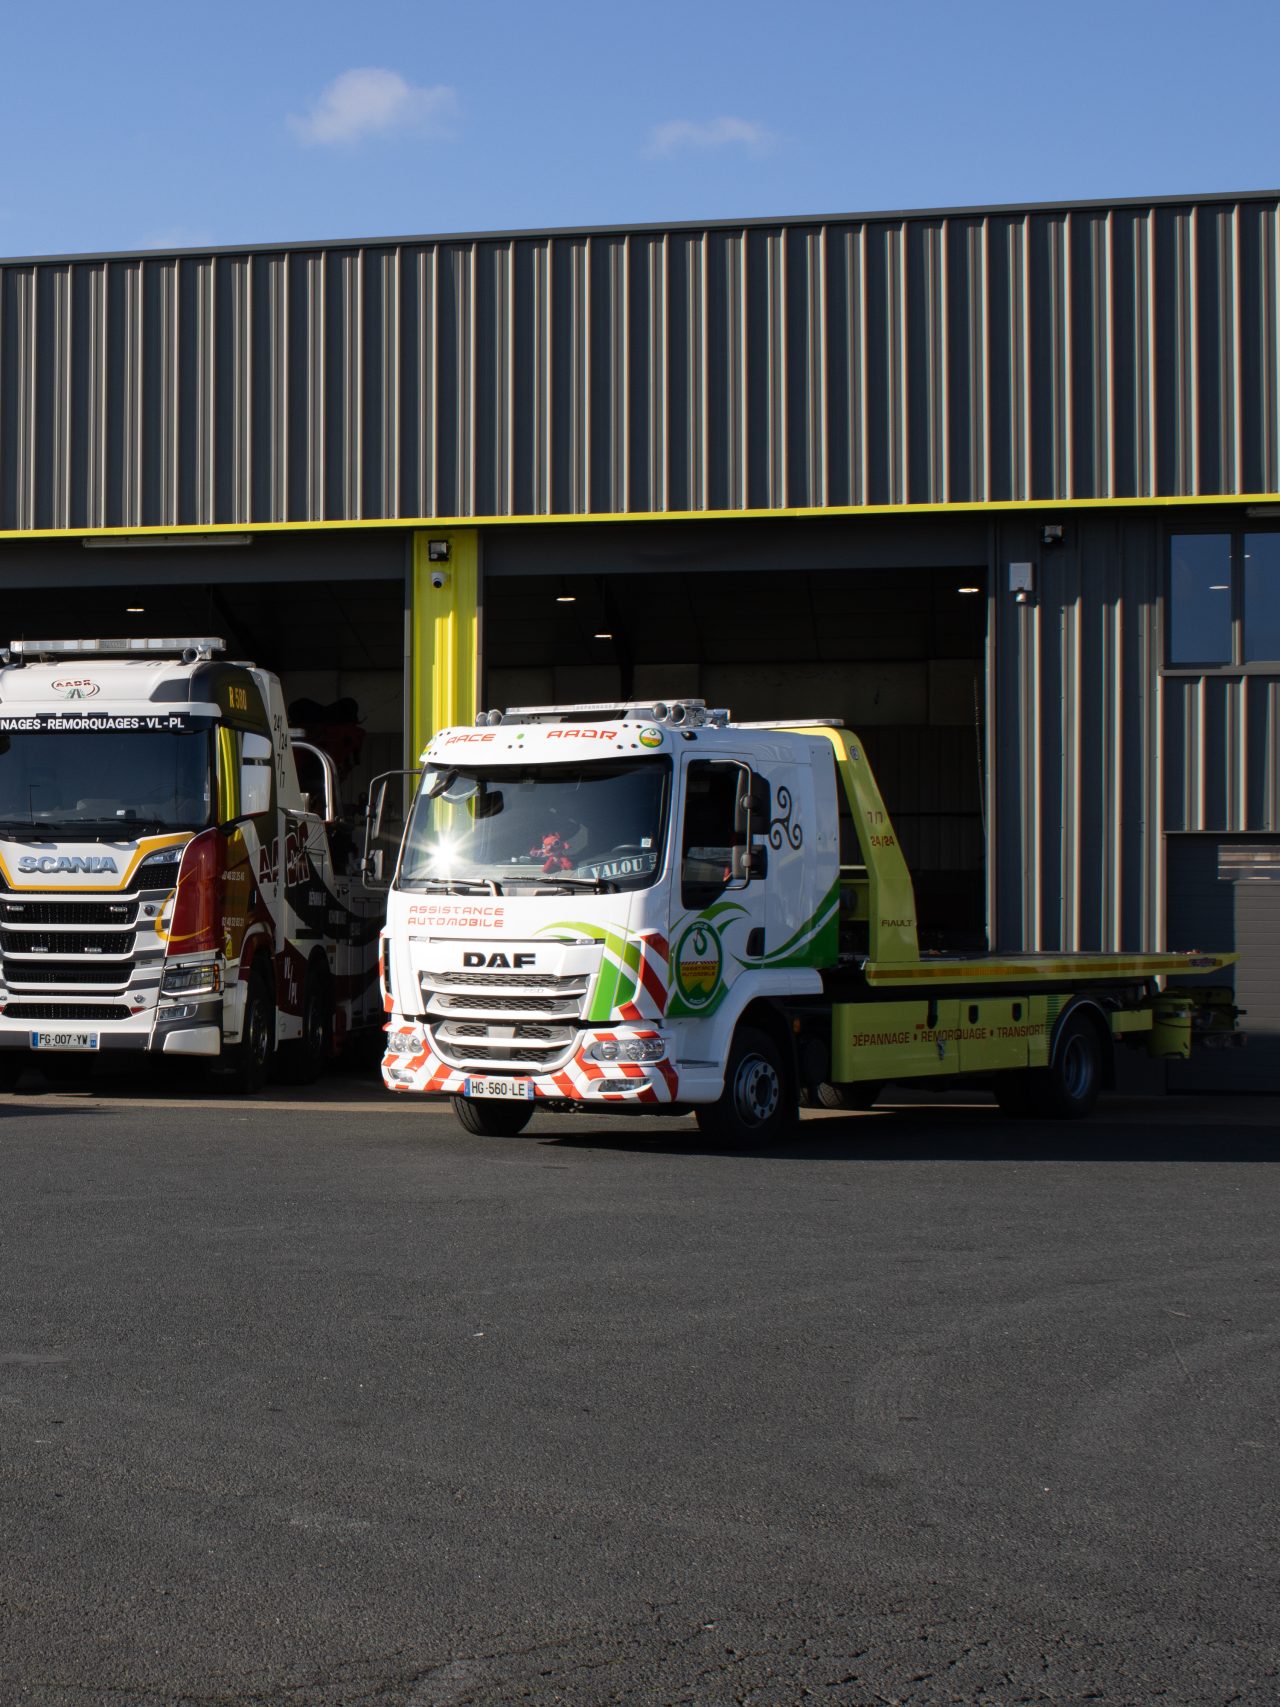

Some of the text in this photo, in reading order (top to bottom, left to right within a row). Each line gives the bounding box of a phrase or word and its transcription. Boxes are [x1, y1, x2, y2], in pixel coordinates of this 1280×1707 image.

[55, 679, 91, 688] AADR
[445, 733, 497, 746] AACE
[546, 729, 618, 741] AADR
[870, 835, 895, 848] 24/24
[18, 856, 119, 874] SCANIA
[591, 858, 644, 880] VALOU
[409, 905, 505, 916] ASSISTANCE
[408, 917, 504, 928] AUTOMOBILE
[463, 952, 536, 968] DAF
[39, 1033, 88, 1045] FG-007-YW
[471, 1081, 525, 1096] HG-560-LE
